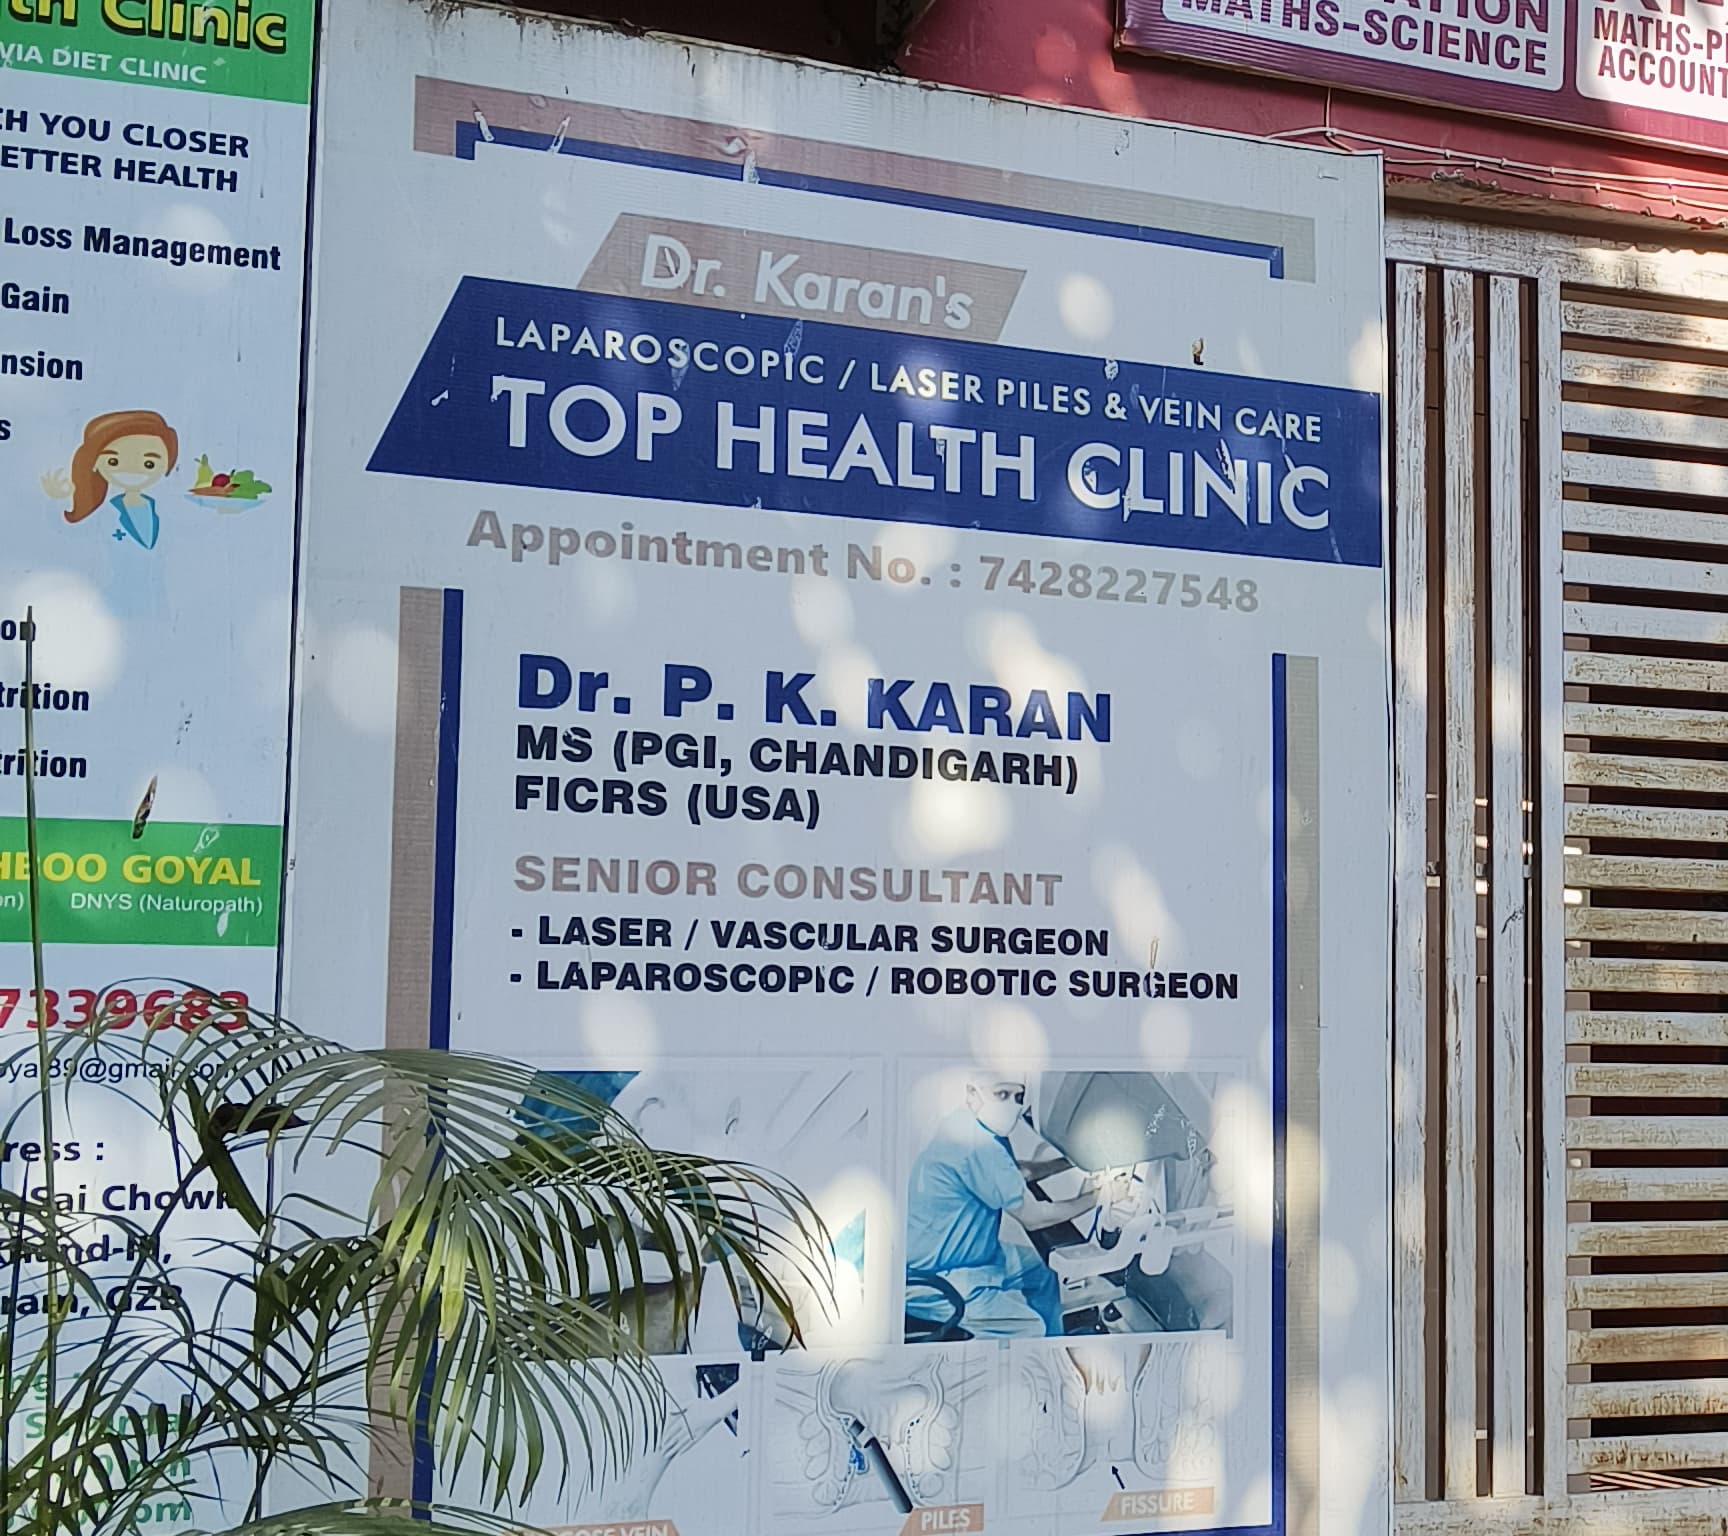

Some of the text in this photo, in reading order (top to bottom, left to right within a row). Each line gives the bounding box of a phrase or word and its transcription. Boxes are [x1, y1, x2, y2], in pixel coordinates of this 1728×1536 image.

[52, 47, 208, 85] DIET CLINIC
[40, 112, 249, 158] YOU CLOSER
[114, 157, 238, 193] HEALTH
[4, 218, 281, 270] Loss Management
[1, 283, 69, 314] Gain
[640, 233, 974, 329] Dr. Karan's
[496, 316, 1321, 443] LAPAROSCOPIC LASER PILES VEIN CARE
[492, 374, 1329, 531] TOP HEALTH CLINIC
[466, 508, 1259, 612] Appointment No. 7428227548
[518, 653, 1111, 742] Dr. P. K. KARAN
[516, 724, 1078, 795] MS (PGI, CHANDIGARH)
[515, 774, 820, 830] FICRS (USA)
[122, 855, 261, 886] GOYAL
[513, 855, 1063, 906] SENIOR CONSULTANT
[71, 893, 263, 917] DNYS (Naturopath)
[538, 915, 1109, 957] LASER VASCULAR SURGEON
[537, 960, 1239, 999] LAPAROSCOPIC ROBOTIC SURGEON
[921, 1508, 970, 1530] PILES
[1121, 1492, 1195, 1516] FISSURE
